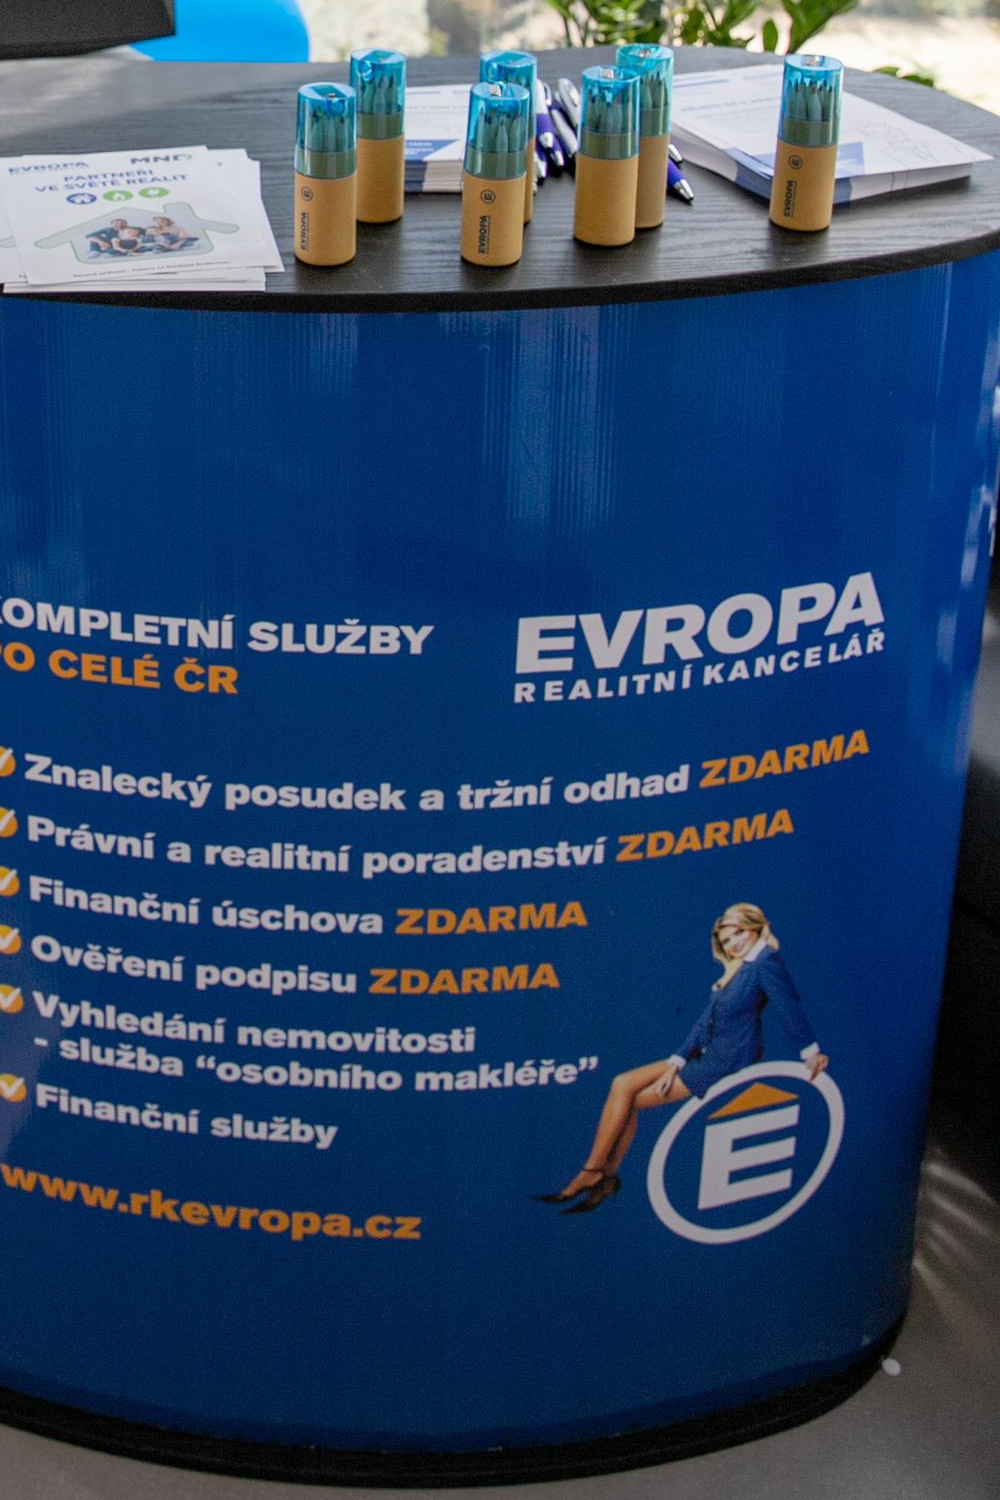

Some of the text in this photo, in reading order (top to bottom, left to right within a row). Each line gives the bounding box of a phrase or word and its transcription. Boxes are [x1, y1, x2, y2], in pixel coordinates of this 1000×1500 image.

[35, 184, 60, 193] VE
[126, 174, 188, 185] REALIT
[478, 215, 488, 254] EVROPA
[246, 618, 434, 655] SLUŽBY
[515, 571, 886, 674] EVROPA
[48, 647, 161, 689] CELÉ
[173, 656, 239, 695] ČR
[513, 629, 886, 704] REALITNÍ KANCELÁŘ
[23, 729, 870, 812] Znalecký posudek a tržní odhad ZDARMA
[27, 808, 795, 879] Právní a realitní poradenství ZDARMA
[29, 874, 589, 936] Finanční úschova ZDARMA
[30, 934, 561, 997] Ověření podpisu ZDARMA
[32, 989, 476, 1054] Vyhledání nemovitosti
[58, 1032, 184, 1078] služba
[195, 1054, 403, 1092] “osobního
[414, 1055, 599, 1092] makléře”
[34, 1082, 339, 1149] Finanční služby
[0, 1161, 423, 1241] www.rkevropa.cz
